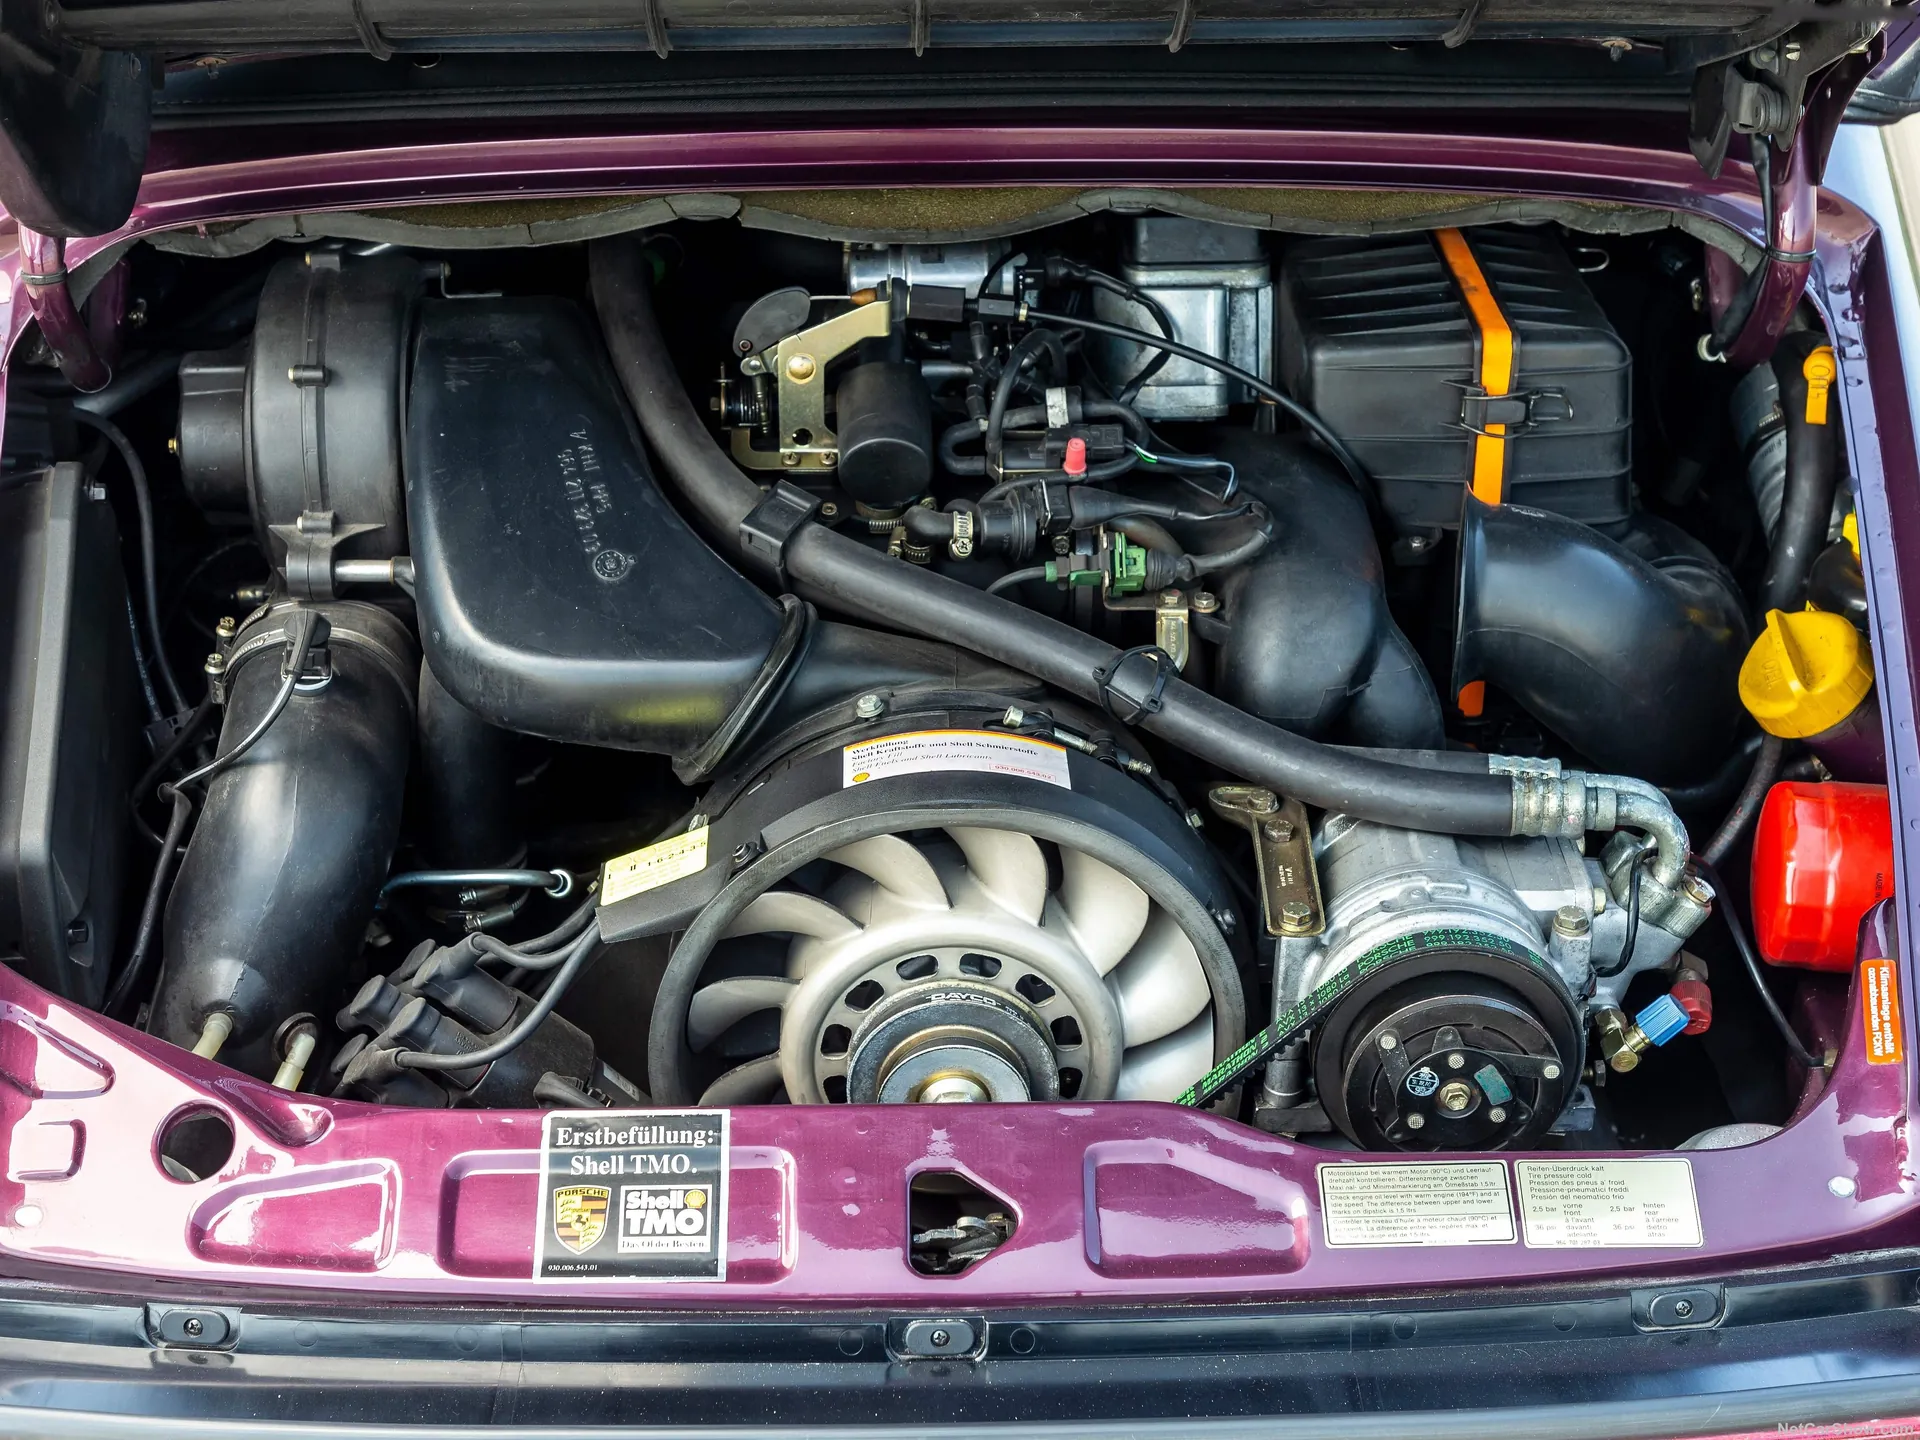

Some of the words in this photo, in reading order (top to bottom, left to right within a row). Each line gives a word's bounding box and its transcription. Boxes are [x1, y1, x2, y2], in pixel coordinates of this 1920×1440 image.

[851, 752, 873, 761] Shell
[876, 743, 926, 755] Kraftstoffe
[975, 742, 1039, 756] Schmierstoffe
[1875, 873, 1883, 891] MADE
[931, 992, 997, 1006] DAYCO
[1880, 966, 1892, 1021] Klimaanlage
[1202, 1042, 1257, 1089] MARATHON
[1277, 1013, 1295, 1031] AVX
[1298, 1004, 1307, 1015] 13
[1317, 983, 1337, 999] 1080
[1339, 974, 1350, 983] La
[1357, 940, 1415, 970] PORSCHE
[1424, 934, 1512, 950] 999.192.352.50
[1872, 1031, 1884, 1057] FCKW
[555, 1125, 715, 1148] Erstbefüllung:
[570, 1154, 625, 1176] Shell
[629, 1153, 698, 1174] TMO.
[557, 1188, 607, 1198] PORSCHE
[625, 1189, 685, 1210] Shell
[625, 1208, 705, 1235] TMO
